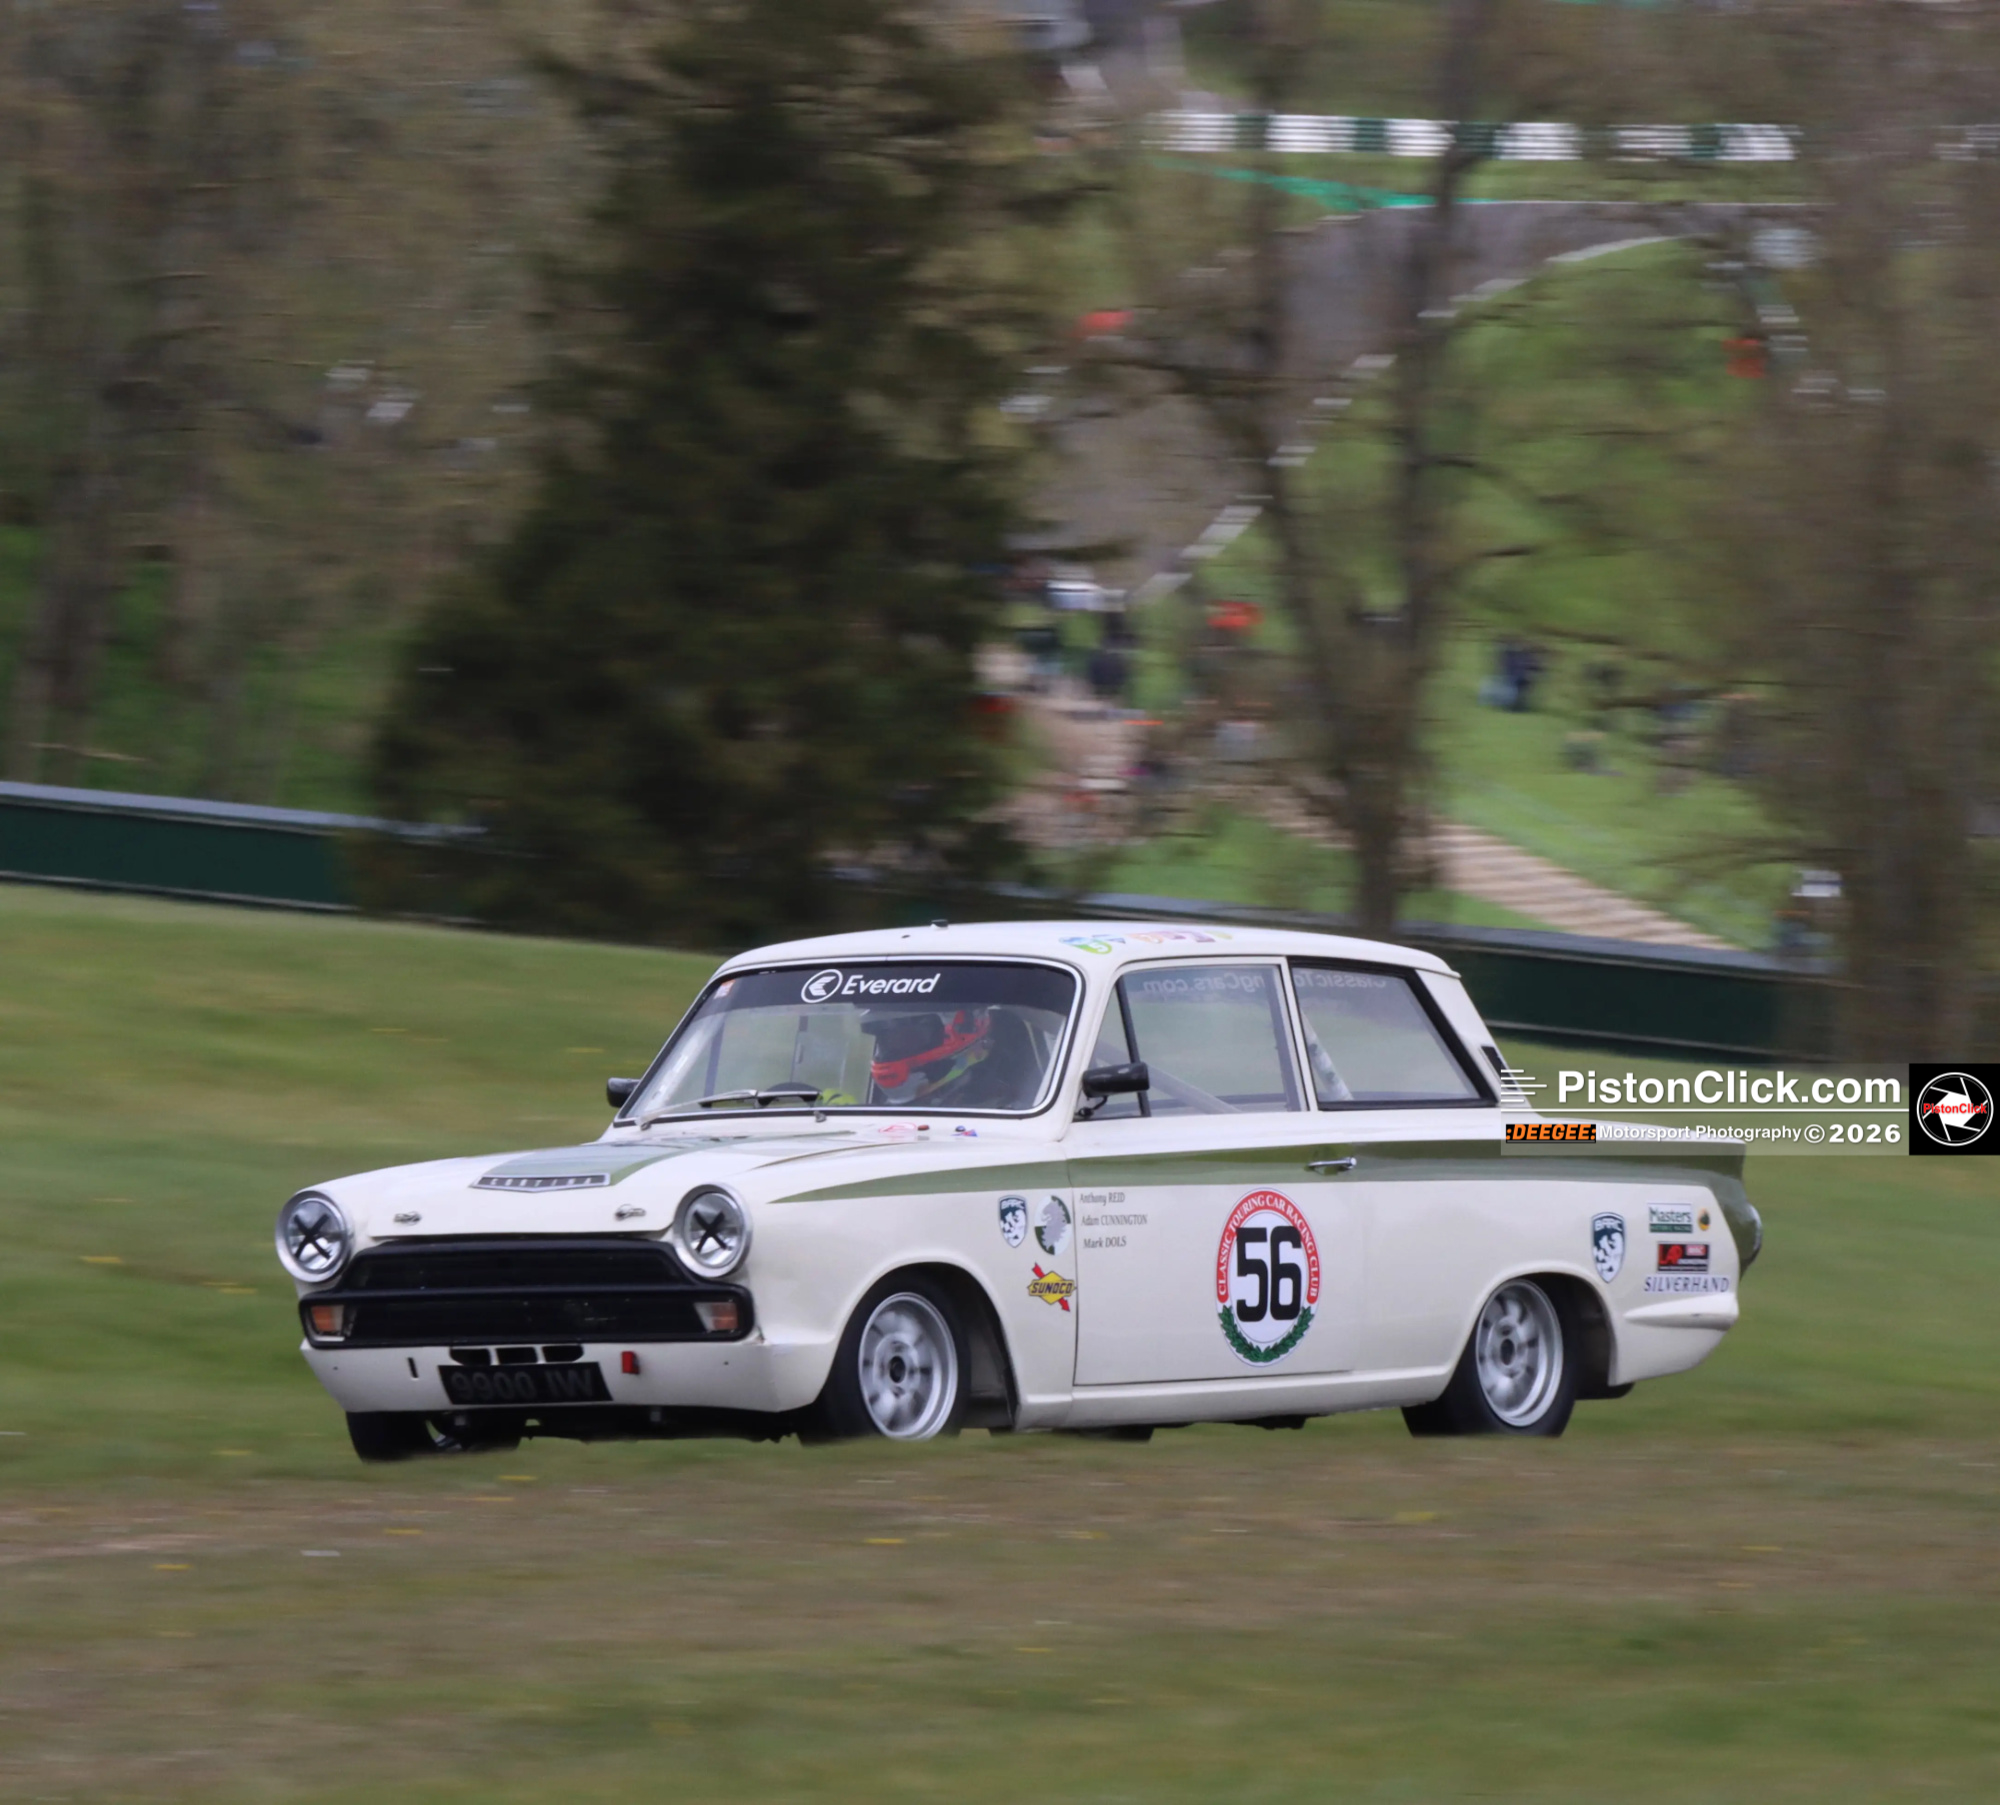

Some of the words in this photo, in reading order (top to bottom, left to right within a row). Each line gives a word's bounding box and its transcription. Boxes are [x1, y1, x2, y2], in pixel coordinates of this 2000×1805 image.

[841, 973, 941, 995] Everard
[490, 1177, 593, 1188] CORTINA
[1080, 1192, 1107, 1207] Anthony
[1108, 1191, 1126, 1203] REID
[1081, 1214, 1100, 1226] Adam
[1101, 1213, 1149, 1226] CUNNINGTON
[1649, 1206, 1692, 1222] Masters
[1083, 1237, 1104, 1249] Mark
[1105, 1235, 1127, 1248] DOLS
[1218, 1232, 1233, 1296] CLASSIC
[1228, 1194, 1265, 1233] TOURING
[1265, 1194, 1286, 1212] CAR
[1286, 1204, 1315, 1254] RACING
[1309, 1255, 1319, 1297] CLUB
[1235, 1225, 1302, 1322] 56
[1030, 1280, 1074, 1295] SUNOCO
[1643, 1276, 1730, 1293] SILVERHAND
[450, 1371, 537, 1400] 9900
